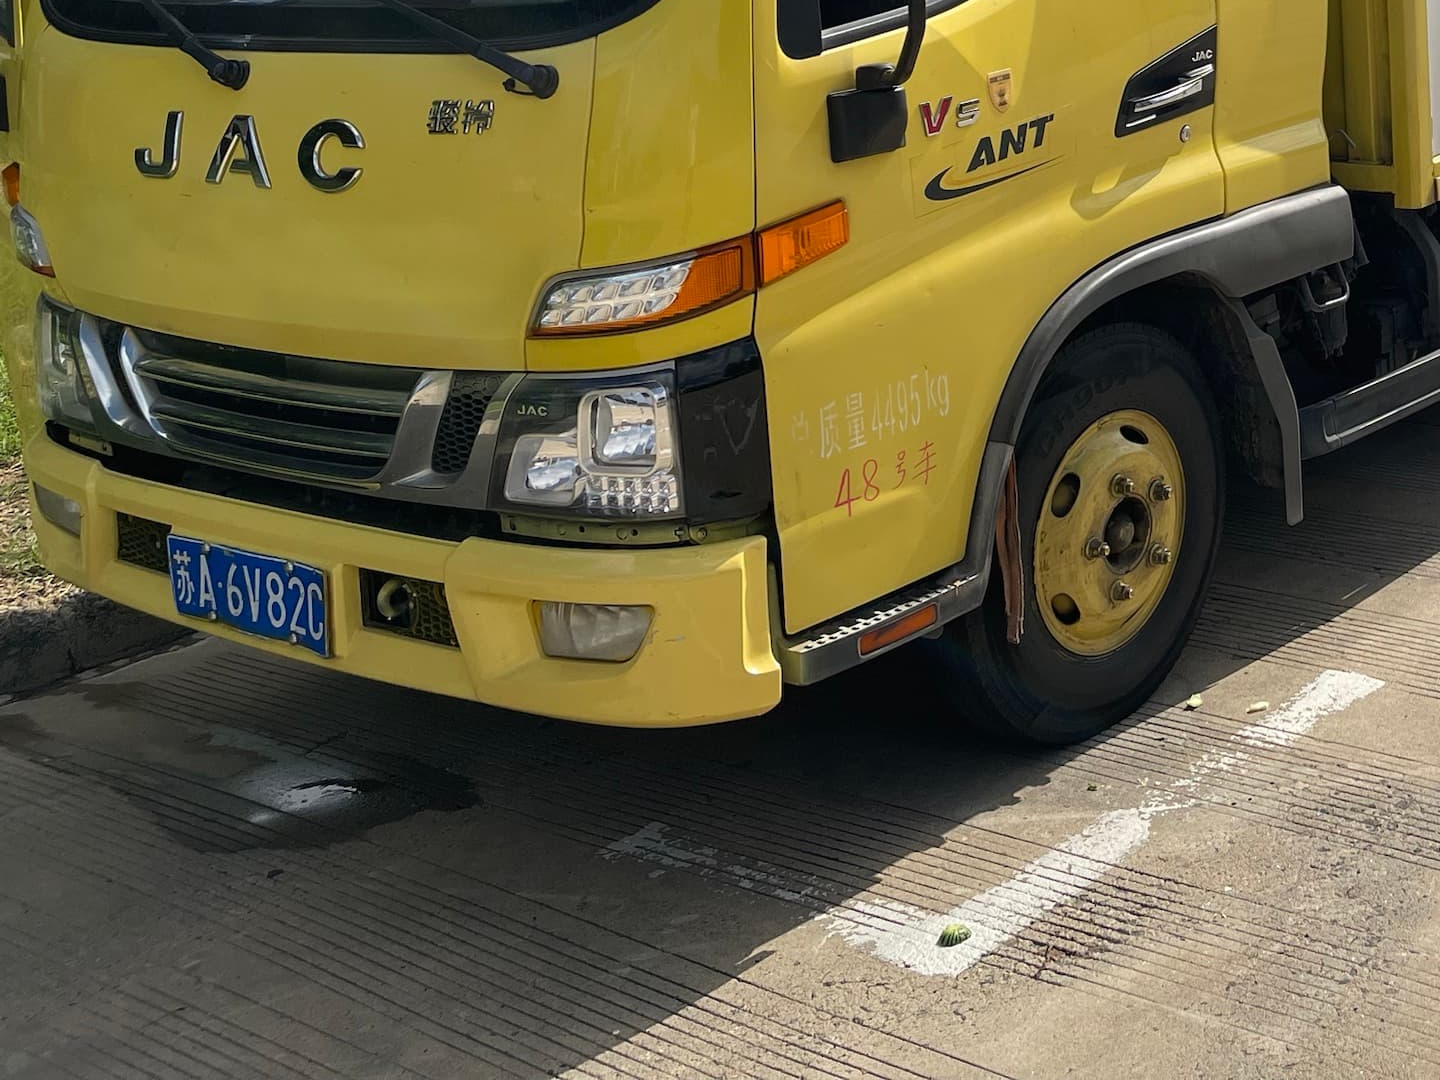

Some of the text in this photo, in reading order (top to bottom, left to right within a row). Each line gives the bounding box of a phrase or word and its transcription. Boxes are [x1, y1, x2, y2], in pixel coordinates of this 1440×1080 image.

[1191, 49, 1213, 63] JAC
[134, 110, 366, 193] JAC
[966, 113, 1055, 173] ANT
[517, 405, 548, 417] JAC
